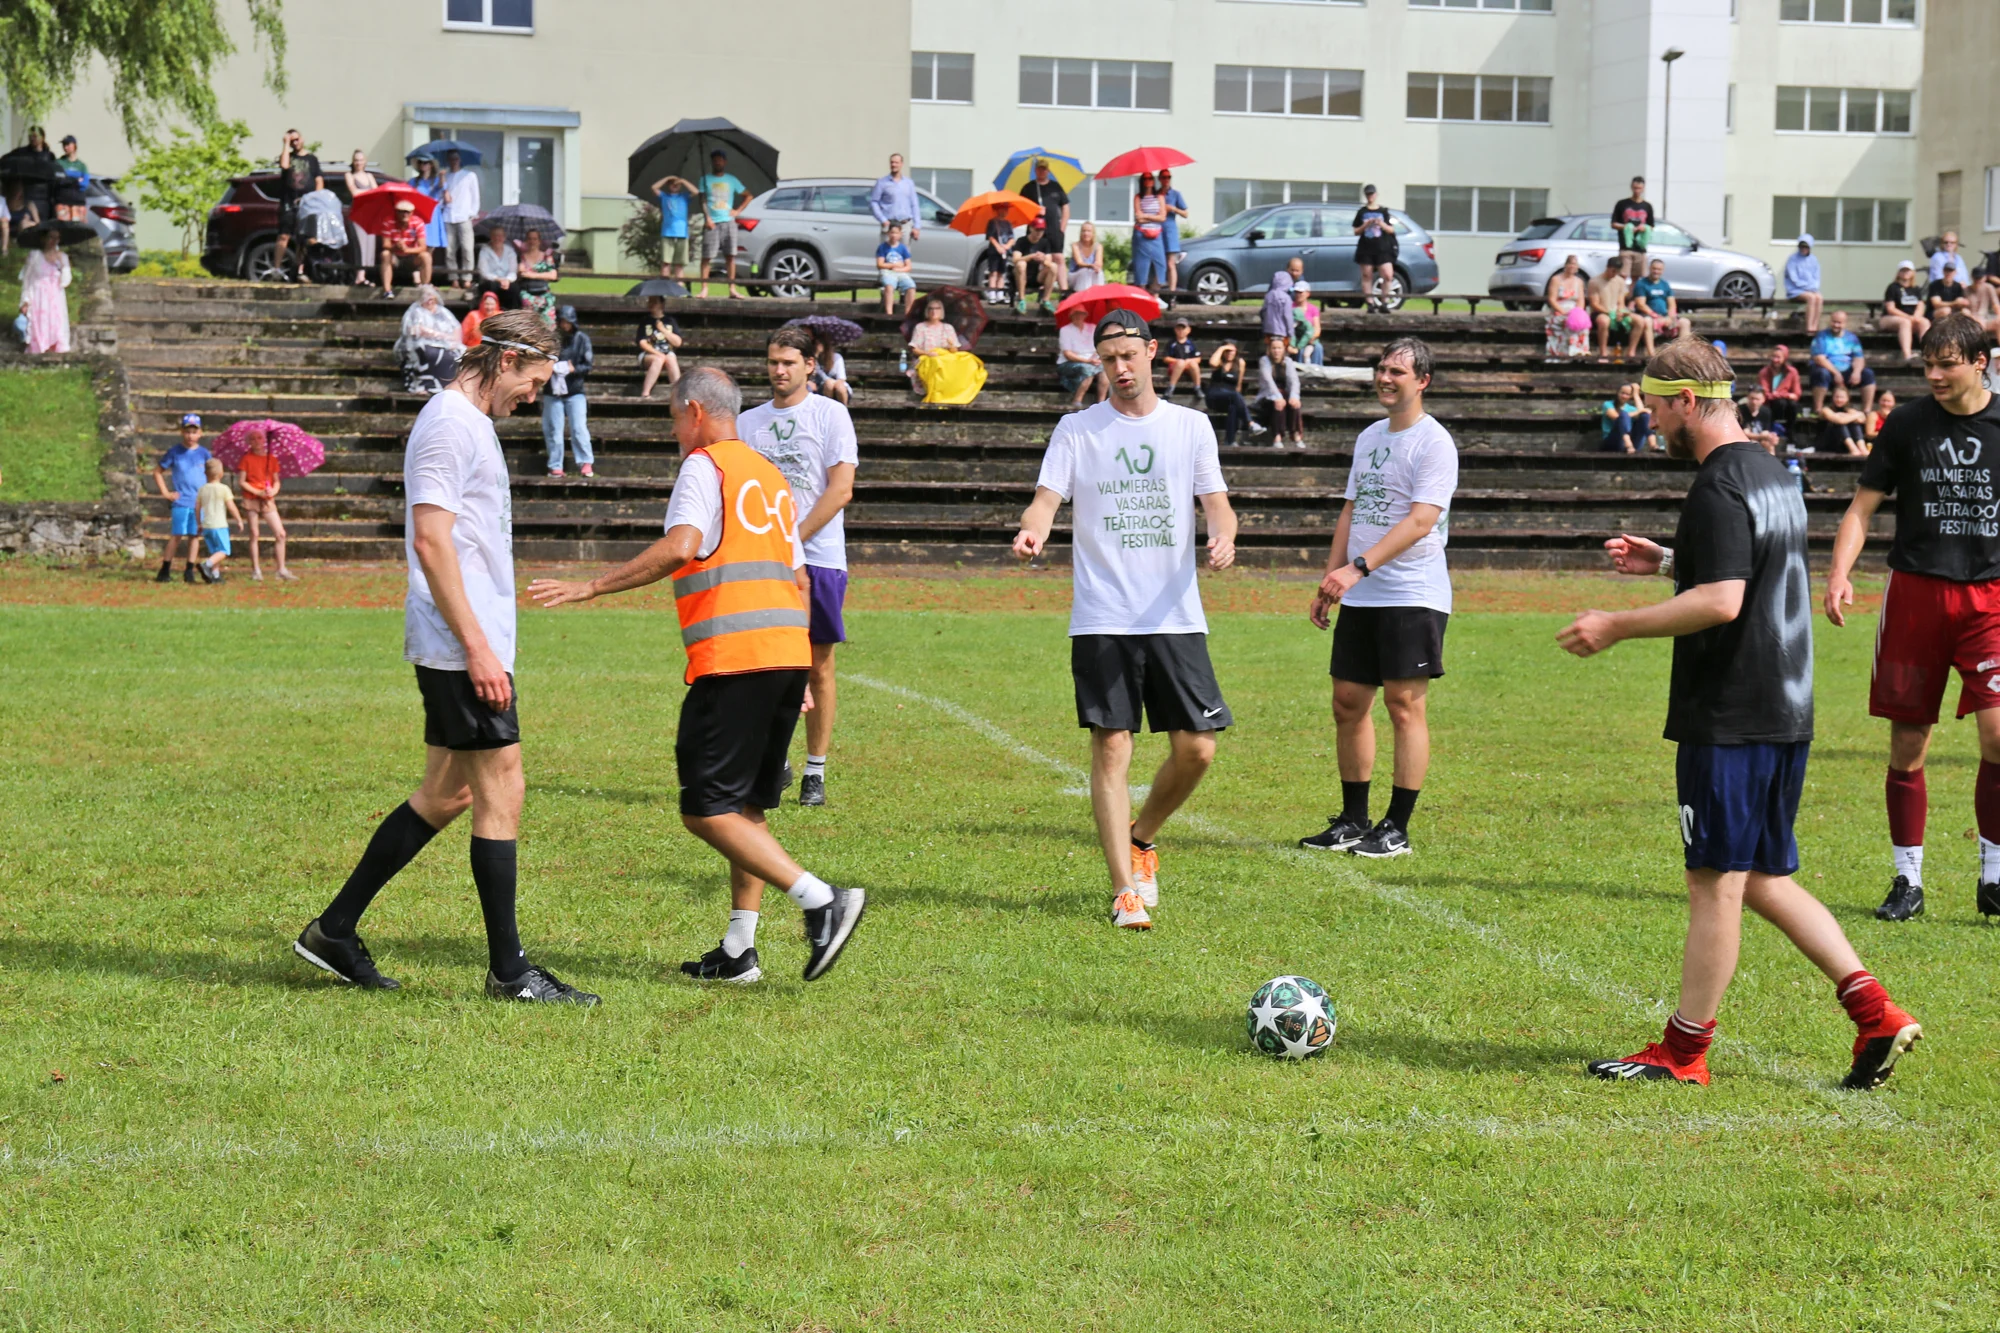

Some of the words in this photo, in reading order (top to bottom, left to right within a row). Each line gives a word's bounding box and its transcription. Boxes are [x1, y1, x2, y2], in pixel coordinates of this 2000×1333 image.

[1920, 468, 1991, 483] VALMIERAS
[1097, 478, 1167, 495] VALMIERAS
[1937, 485, 1993, 500] VASARAS
[1115, 495, 1171, 511] VASARAS
